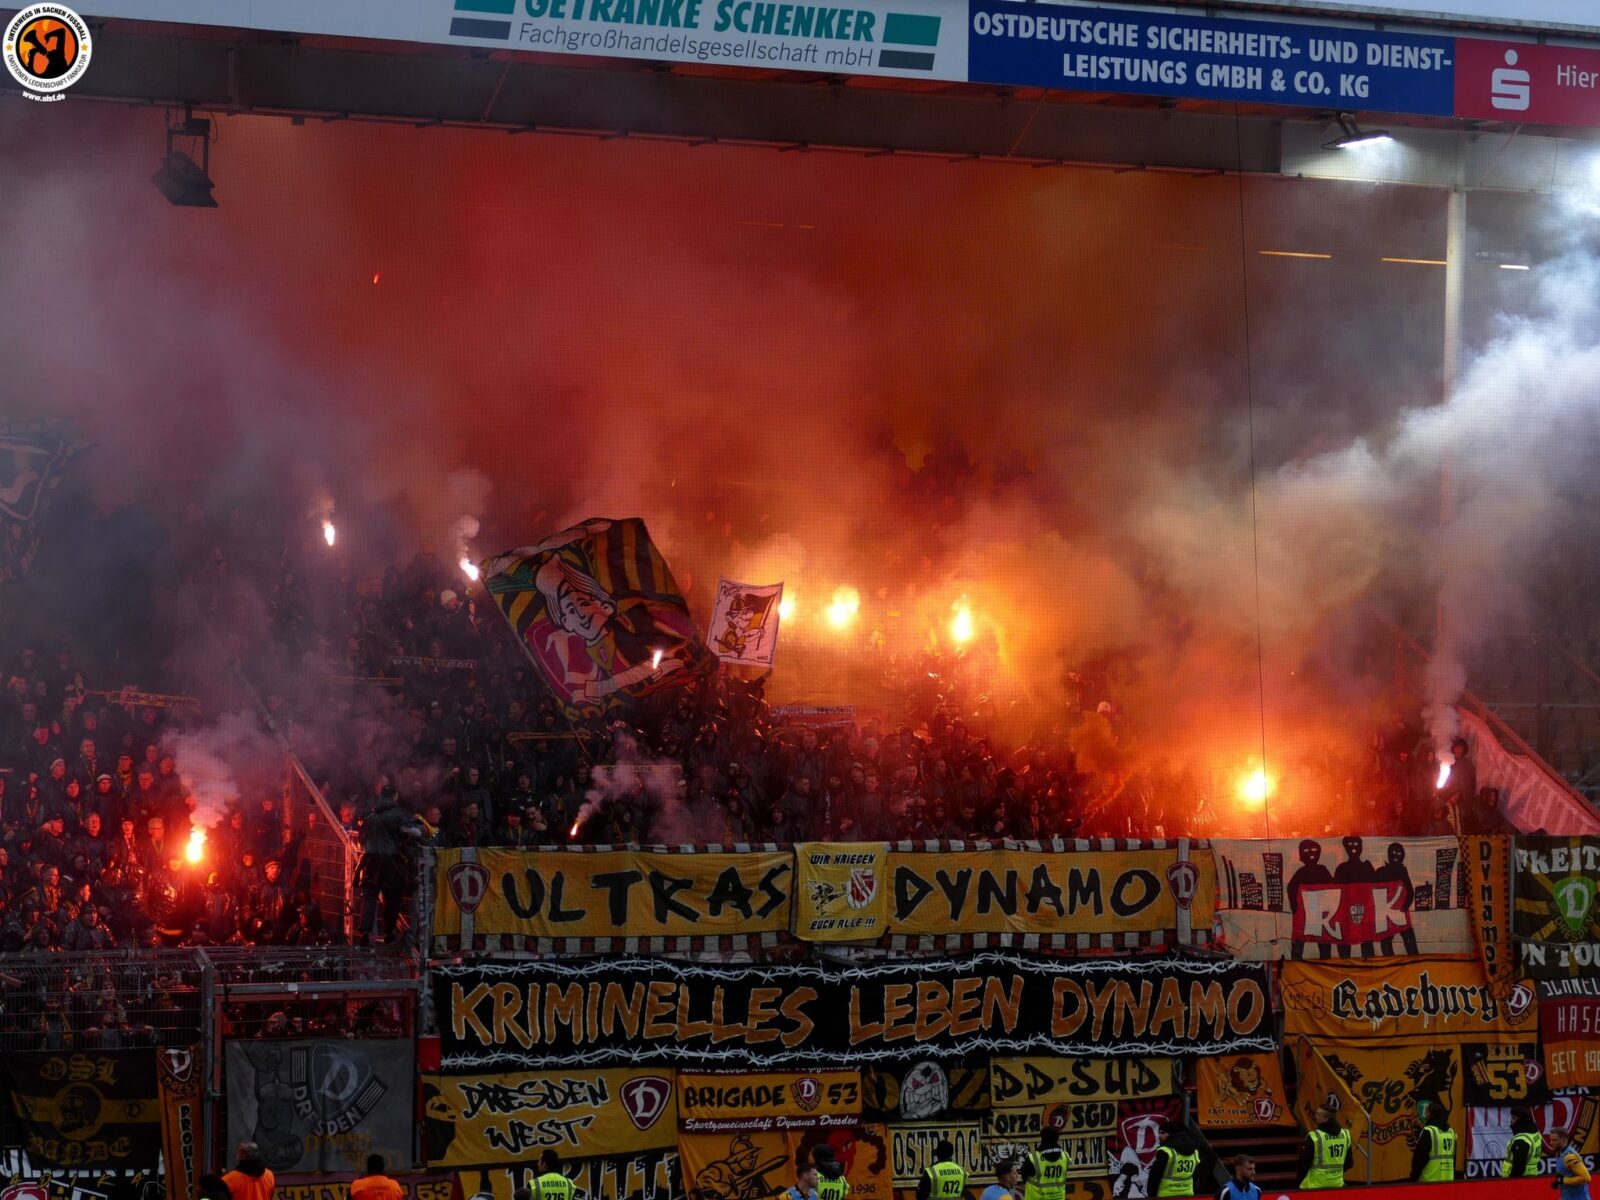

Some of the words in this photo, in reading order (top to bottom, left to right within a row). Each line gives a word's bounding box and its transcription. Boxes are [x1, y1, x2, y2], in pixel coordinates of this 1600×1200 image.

[714, 0, 876, 42] SCHENKER
[519, 22, 818, 63] Fachgroßhandelsgesellschaft
[825, 46, 874, 67] mbH
[973, 11, 1139, 47] OSTDEUTSCHE
[1146, 25, 1301, 59] SICHERHEITS-
[1308, 38, 1359, 64] UND
[1366, 43, 1453, 70] DIENST-
[1063, 53, 1187, 85] LEISTUNGS
[1195, 63, 1262, 90] GMBH
[1270, 68, 1286, 92] &
[1293, 70, 1331, 95] CO.
[1339, 73, 1370, 98] KG
[1557, 64, 1599, 89] Hier
[809, 853, 831, 865] WIR
[501, 863, 791, 927] ULTRAS
[894, 863, 1162, 922] DYNAMO
[810, 918, 835, 930] EUCH
[837, 917, 862, 928] ALLE
[1331, 970, 1499, 1023] Radeburg
[450, 981, 818, 1050] KRIMINELLES
[848, 974, 1025, 1047] LEBEN
[1050, 974, 1266, 1041] DYNAMO
[1551, 1049, 1577, 1075] SEIT
[1487, 1063, 1528, 1100] 53
[458, 1076, 609, 1120] DRESDEN
[685, 1084, 787, 1109] BRIGADE
[827, 1082, 858, 1106] 53
[293, 1085, 362, 1136] DRESDEN
[685, 1116, 773, 1132] Sportgemeinschaft
[775, 1115, 816, 1129] Dynamo
[819, 1113, 858, 1127] Dresden
[1071, 1103, 1116, 1129] SGD
[485, 1115, 595, 1154] WEST
[1328, 1143, 1345, 1158] 167
[1044, 1165, 1062, 1179] 470
[1177, 1159, 1194, 1173] 337
[541, 1180, 567, 1188] ORDNER
[852, 1183, 876, 1194] 1996
[943, 1180, 961, 1194] 472
